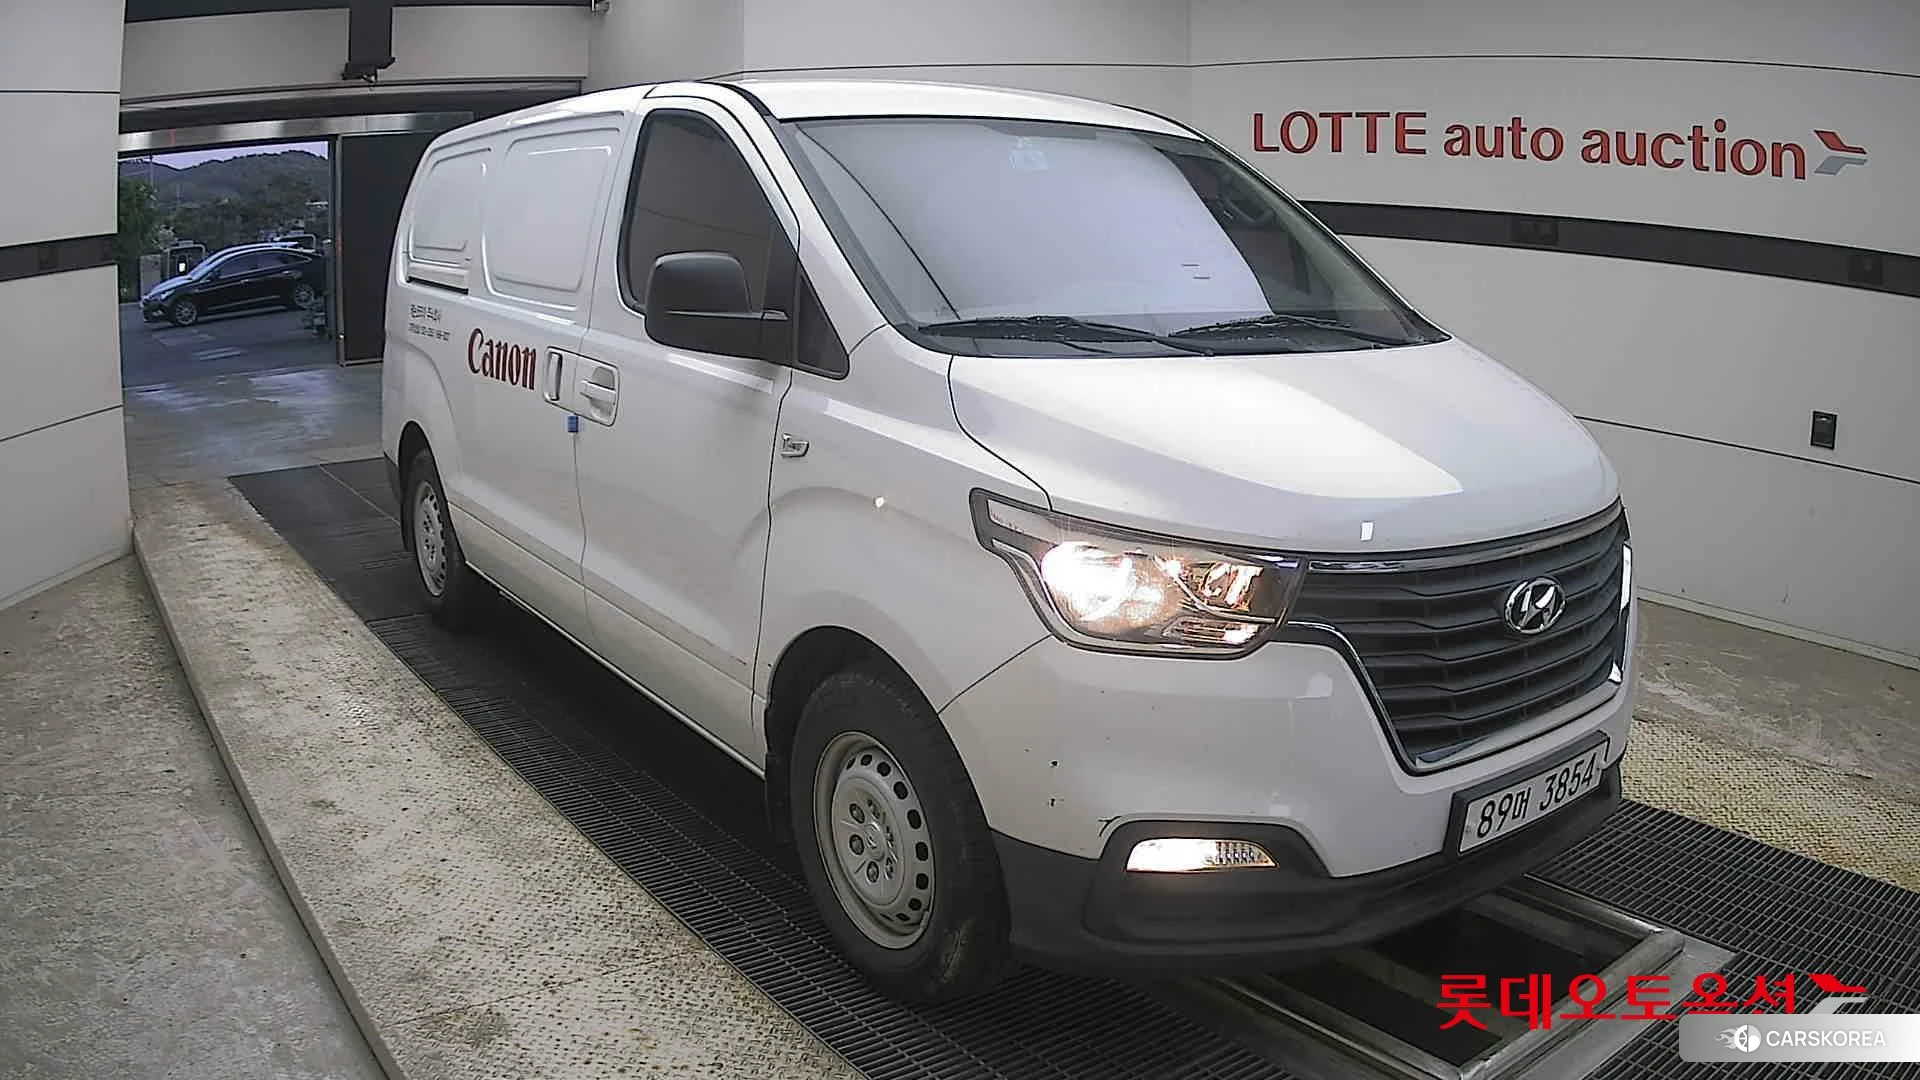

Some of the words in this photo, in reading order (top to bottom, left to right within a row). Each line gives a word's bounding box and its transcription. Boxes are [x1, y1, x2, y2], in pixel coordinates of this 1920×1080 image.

[1253, 111, 1427, 155] LOTTE
[1443, 117, 1565, 162] auto
[1581, 118, 1807, 180] auction
[467, 328, 537, 390] Canon
[1476, 786, 1532, 839] 89머
[1539, 751, 1597, 811] 3854
